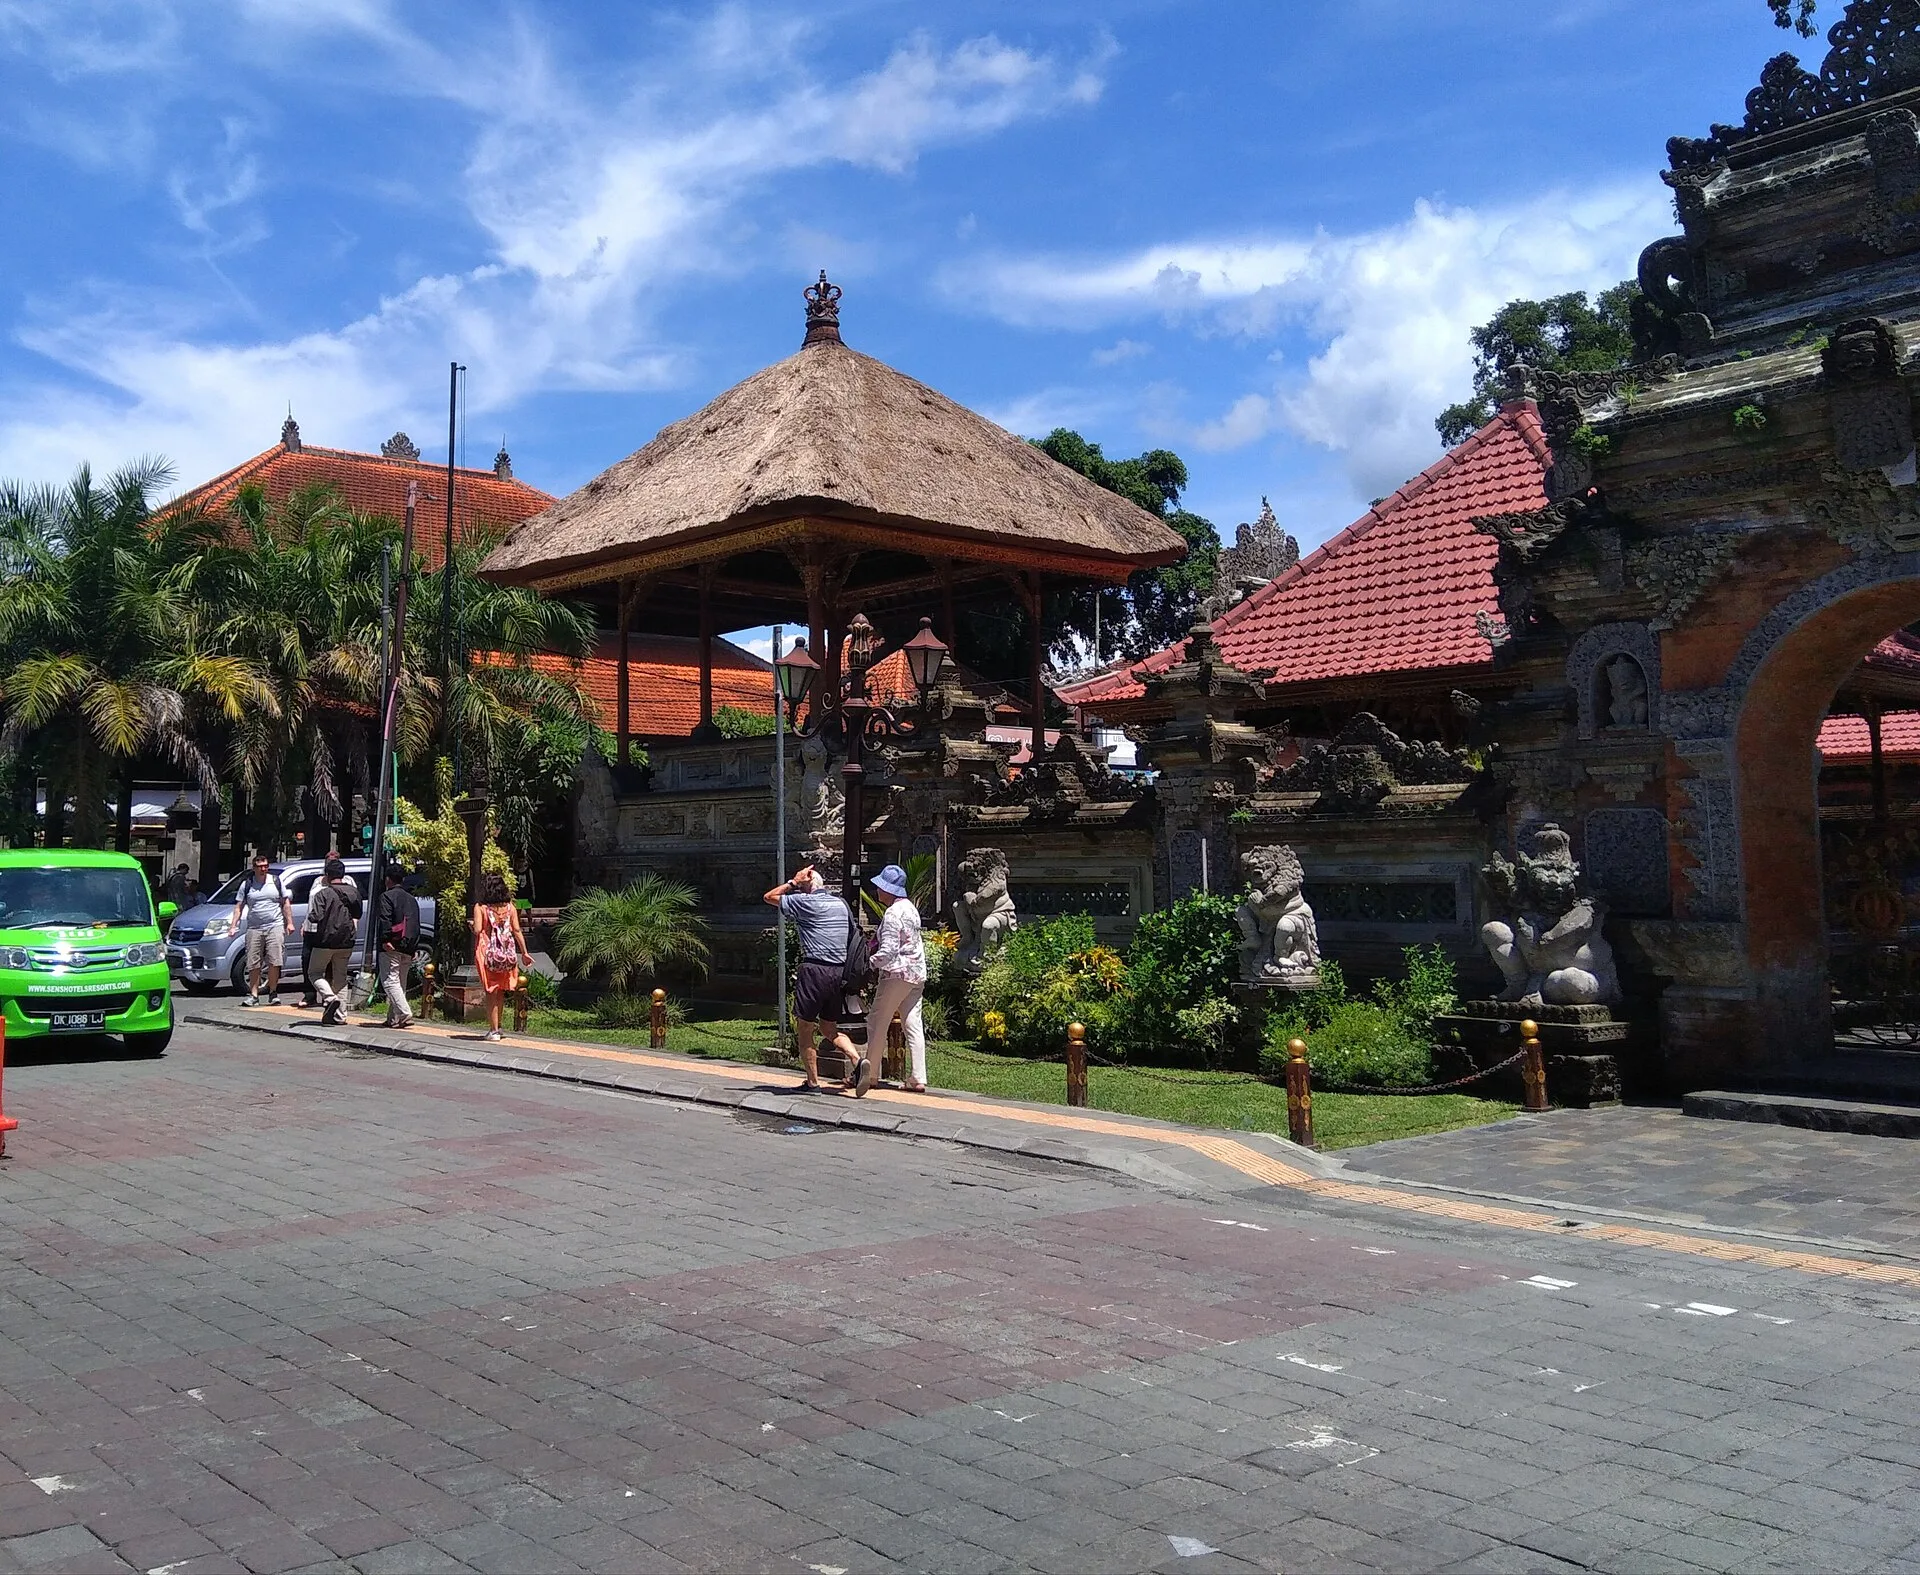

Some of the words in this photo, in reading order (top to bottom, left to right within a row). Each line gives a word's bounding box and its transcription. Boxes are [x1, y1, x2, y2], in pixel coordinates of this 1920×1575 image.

[28, 981, 131, 993] WWW.SENSHOTELSRESORTS.COM
[53, 1014, 66, 1025] DK
[68, 1014, 88, 1025] 1086
[91, 1013, 104, 1024] LJ
